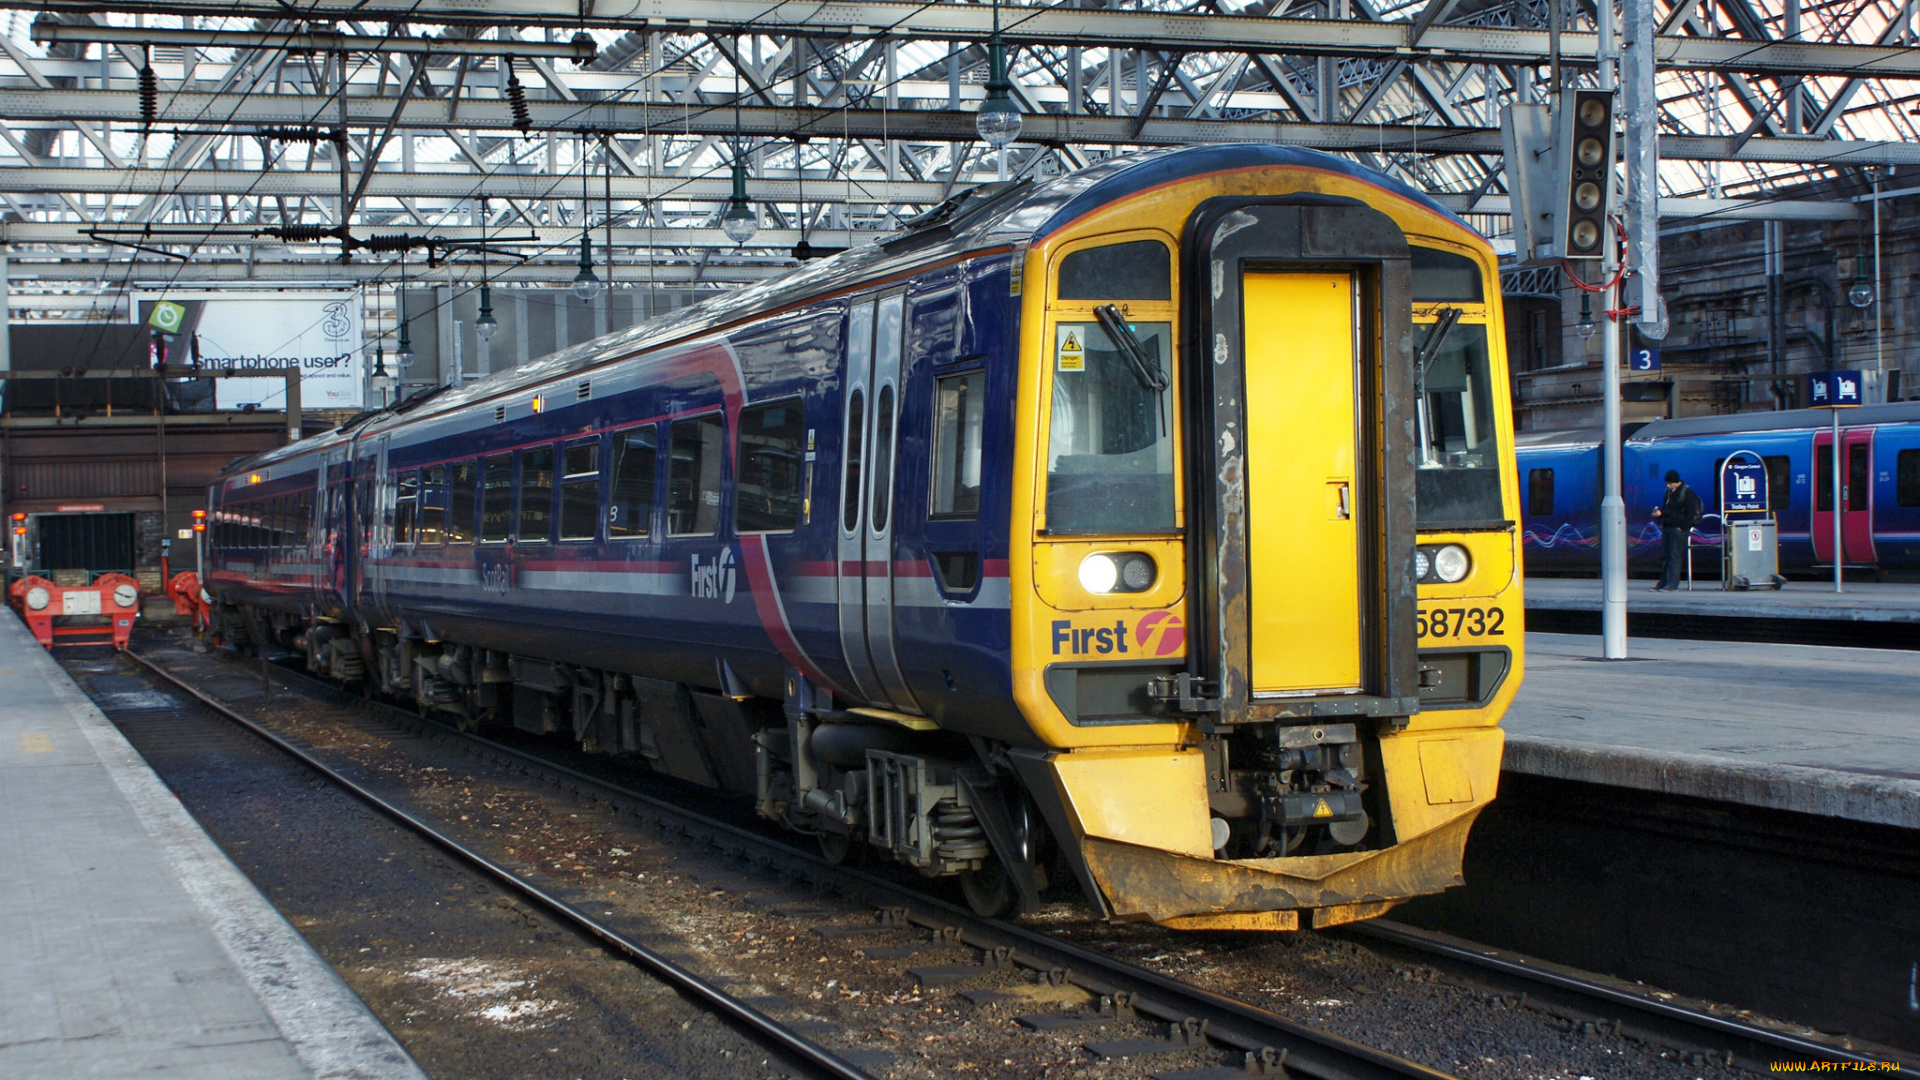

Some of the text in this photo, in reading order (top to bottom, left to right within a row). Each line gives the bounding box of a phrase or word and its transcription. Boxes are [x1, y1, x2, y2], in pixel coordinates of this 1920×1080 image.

[303, 352, 352, 369] user?
[1639, 349, 1652, 370] 3
[691, 553, 718, 599] First
[1052, 620, 1128, 655] First
